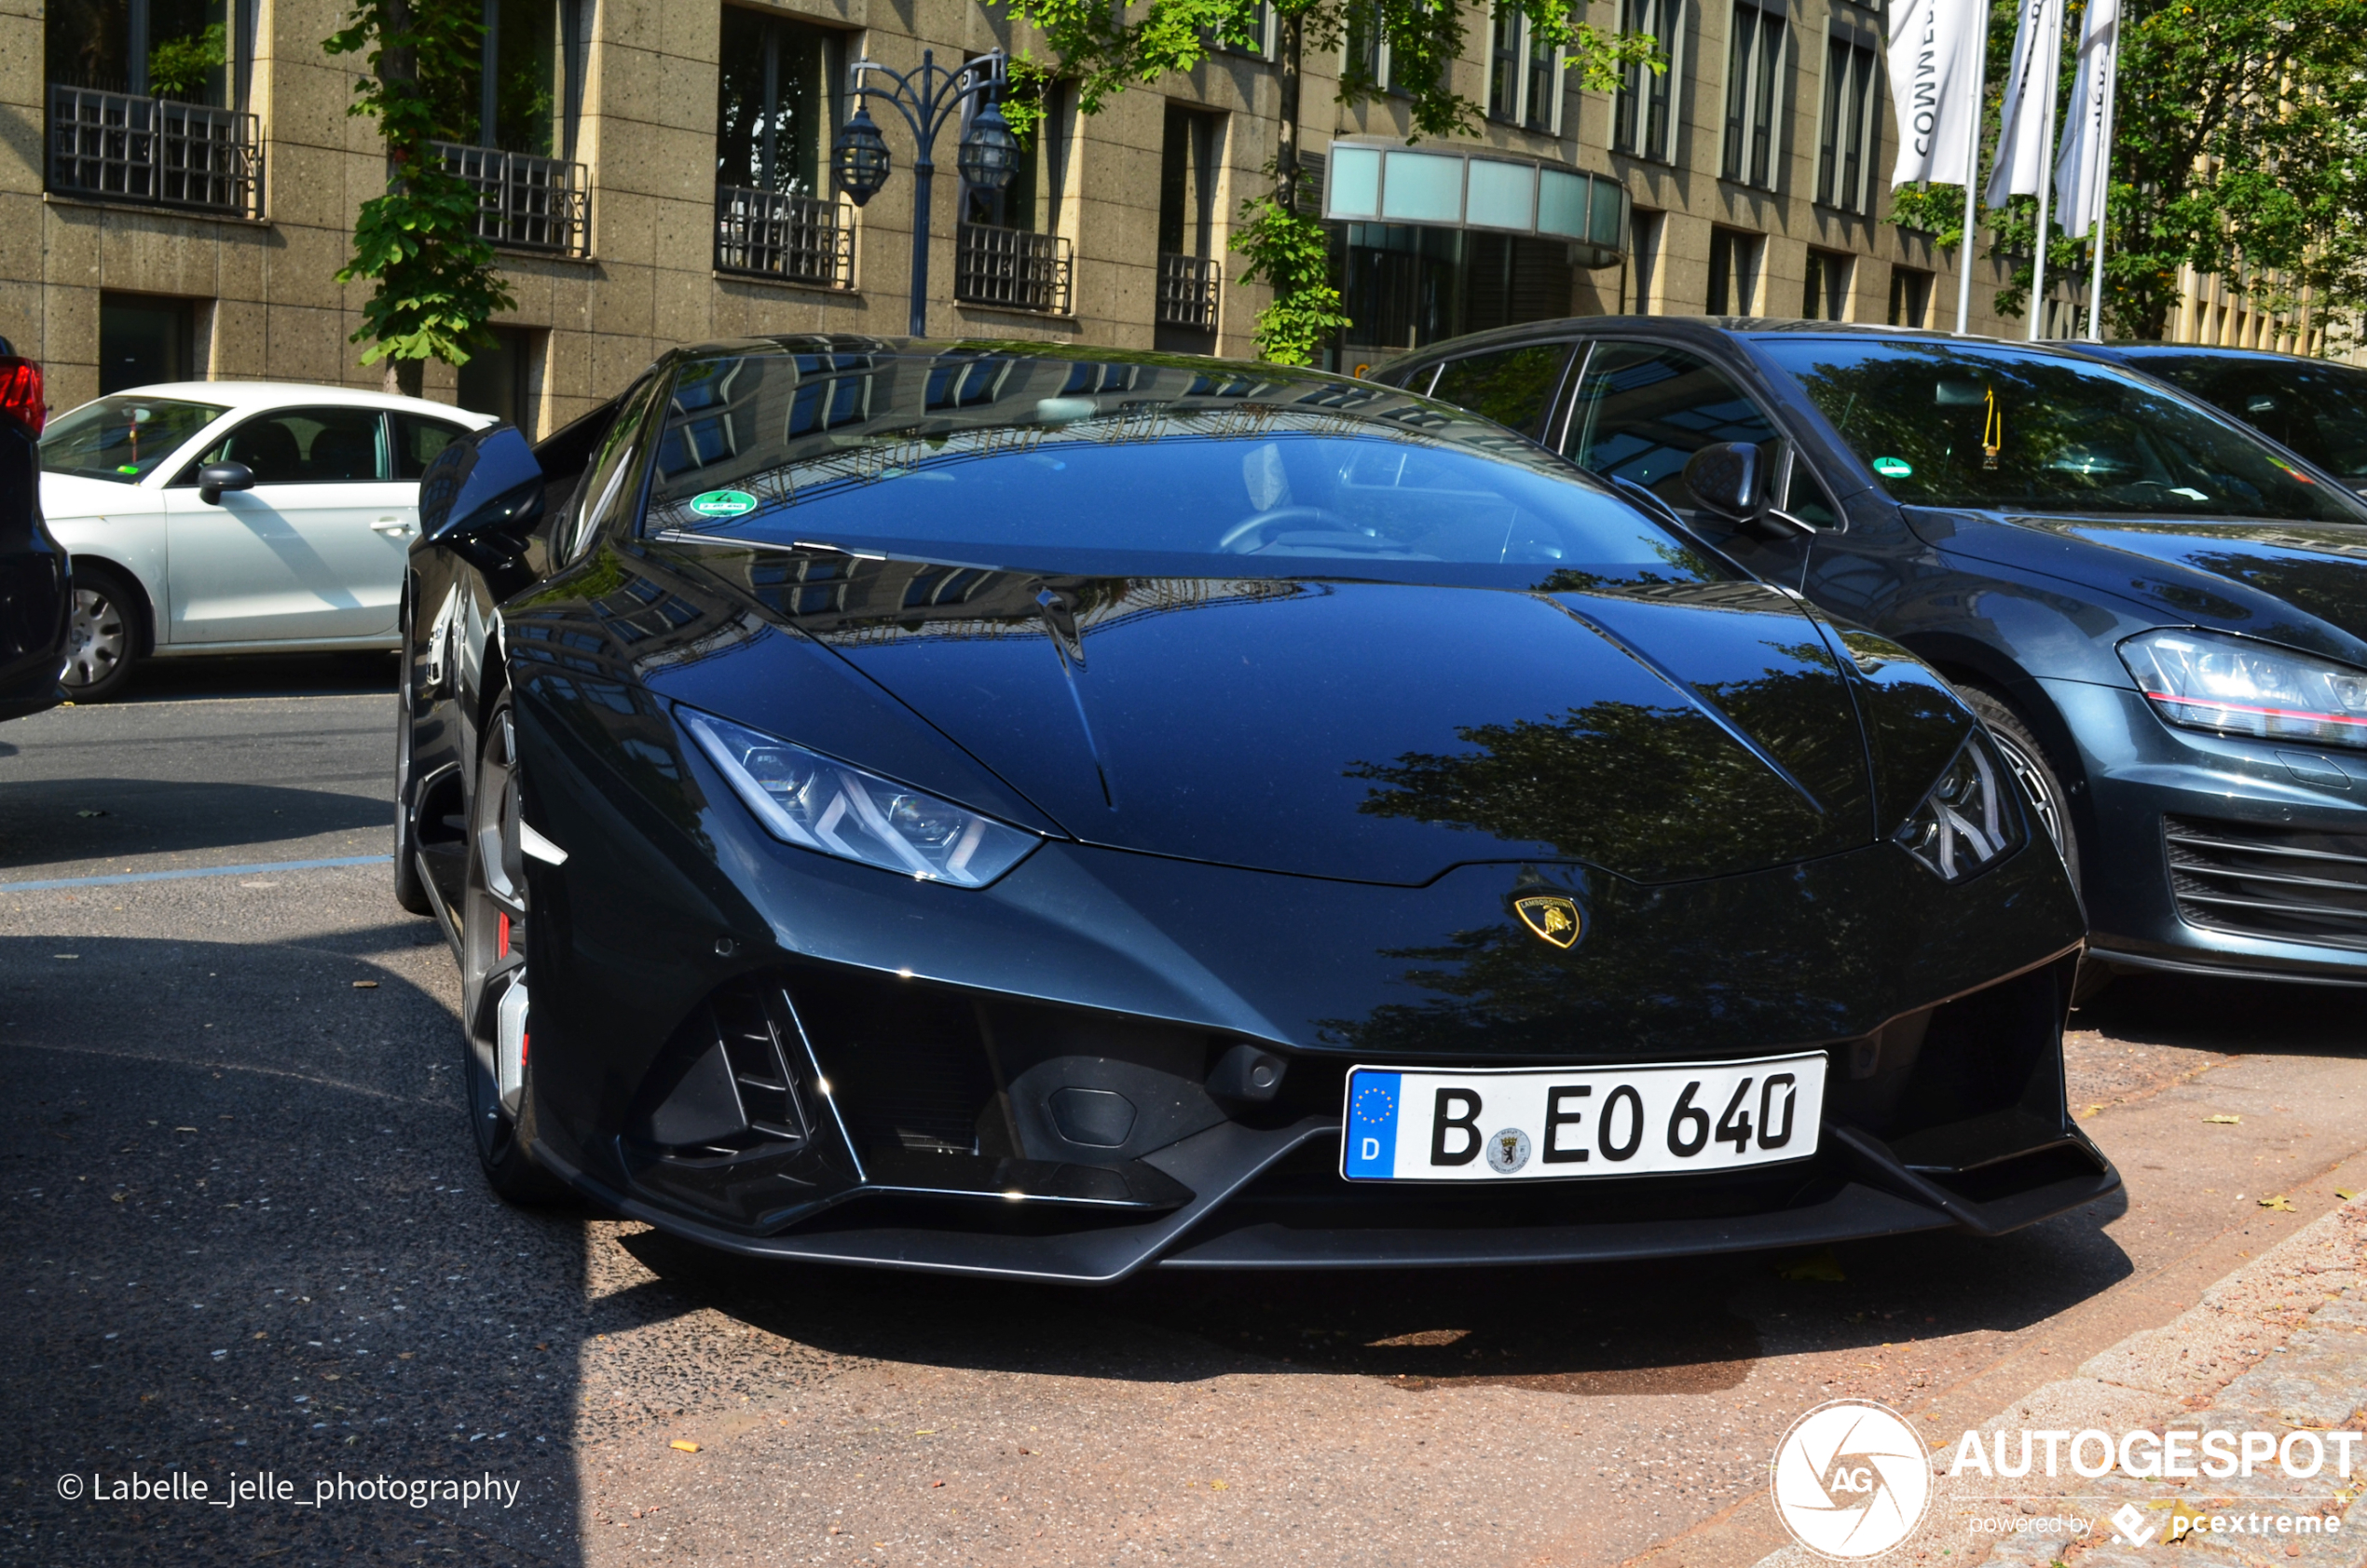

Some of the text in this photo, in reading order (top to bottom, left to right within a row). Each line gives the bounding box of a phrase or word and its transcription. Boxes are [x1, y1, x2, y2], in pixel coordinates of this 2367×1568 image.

[716, 492, 732, 503] 4
[1520, 899, 1571, 909] LAMBORGHINI
[1430, 1072, 1797, 1166] B EO 640
[1361, 1138, 1380, 1160] D
